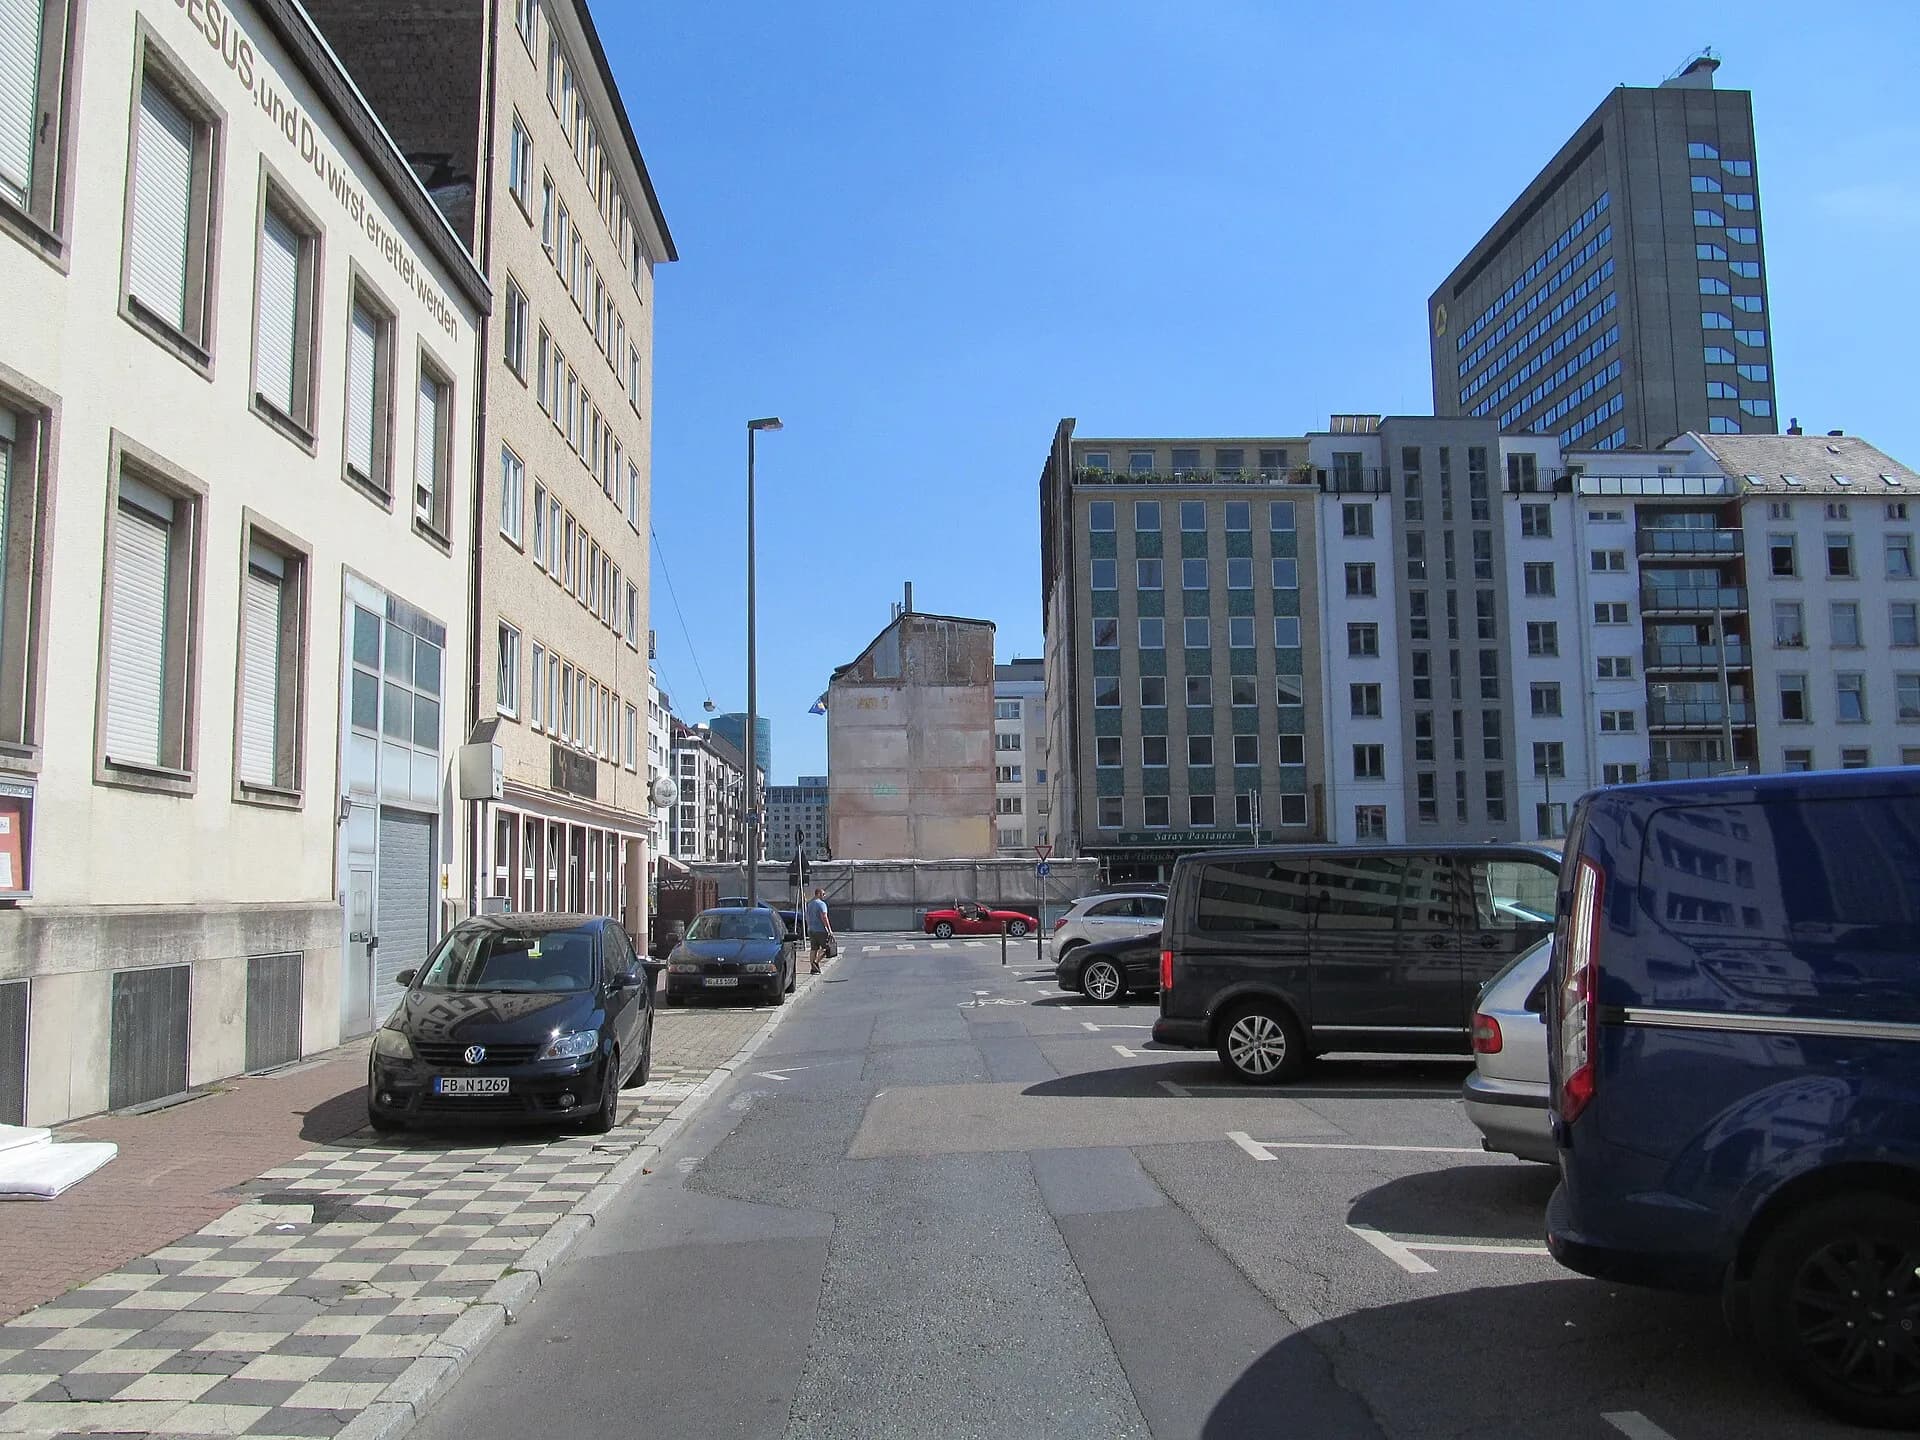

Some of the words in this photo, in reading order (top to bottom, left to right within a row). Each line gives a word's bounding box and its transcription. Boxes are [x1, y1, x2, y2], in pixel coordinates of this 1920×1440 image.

[174, 0, 258, 106] ESUS,
[260, 77, 298, 147] und
[300, 117, 325, 178] Du
[327, 160, 366, 230] wirst
[366, 212, 416, 291] errettet
[416, 272, 459, 343] werden
